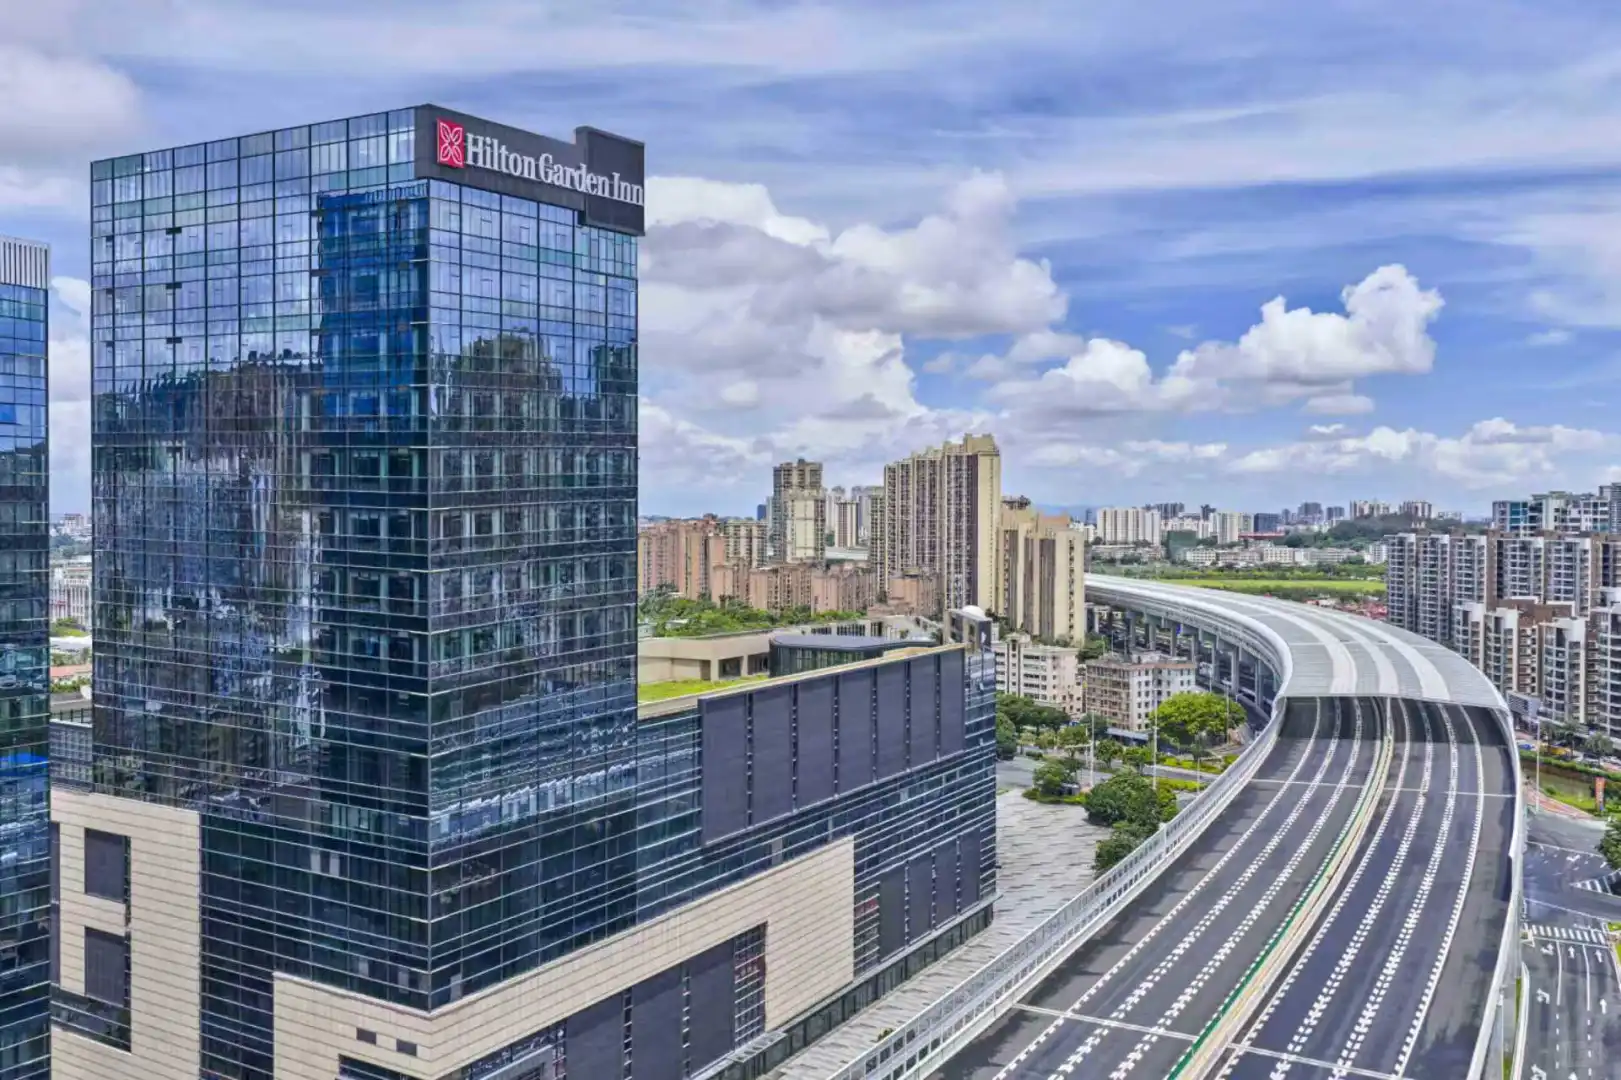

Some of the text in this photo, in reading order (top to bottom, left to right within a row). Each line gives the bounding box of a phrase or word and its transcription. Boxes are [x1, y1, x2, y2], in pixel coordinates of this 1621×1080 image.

[466, 133, 645, 206] Hilton Garden Inn
